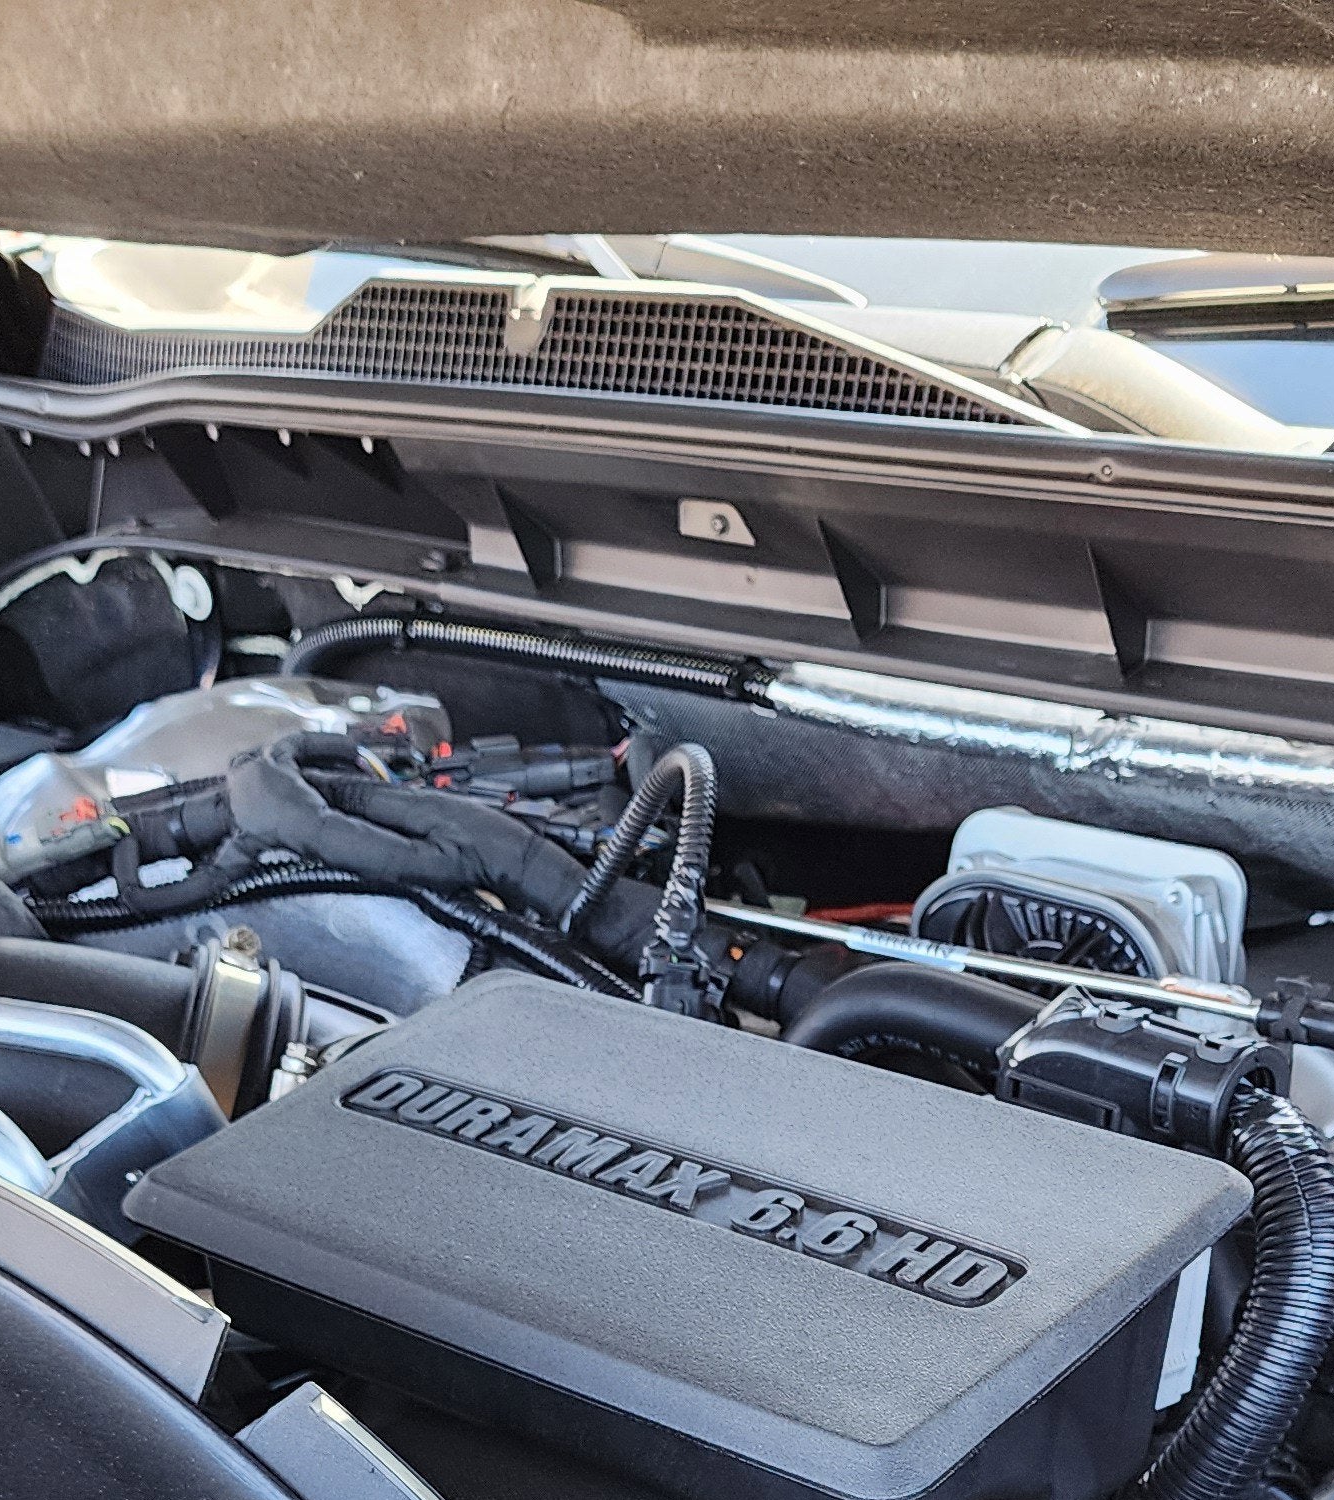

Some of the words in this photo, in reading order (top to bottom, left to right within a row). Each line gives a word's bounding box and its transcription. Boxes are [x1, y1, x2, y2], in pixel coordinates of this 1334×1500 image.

[351, 1073, 730, 1209] DURAMAX
[731, 1189, 877, 1256] 6.6
[876, 1232, 1010, 1301] HD
